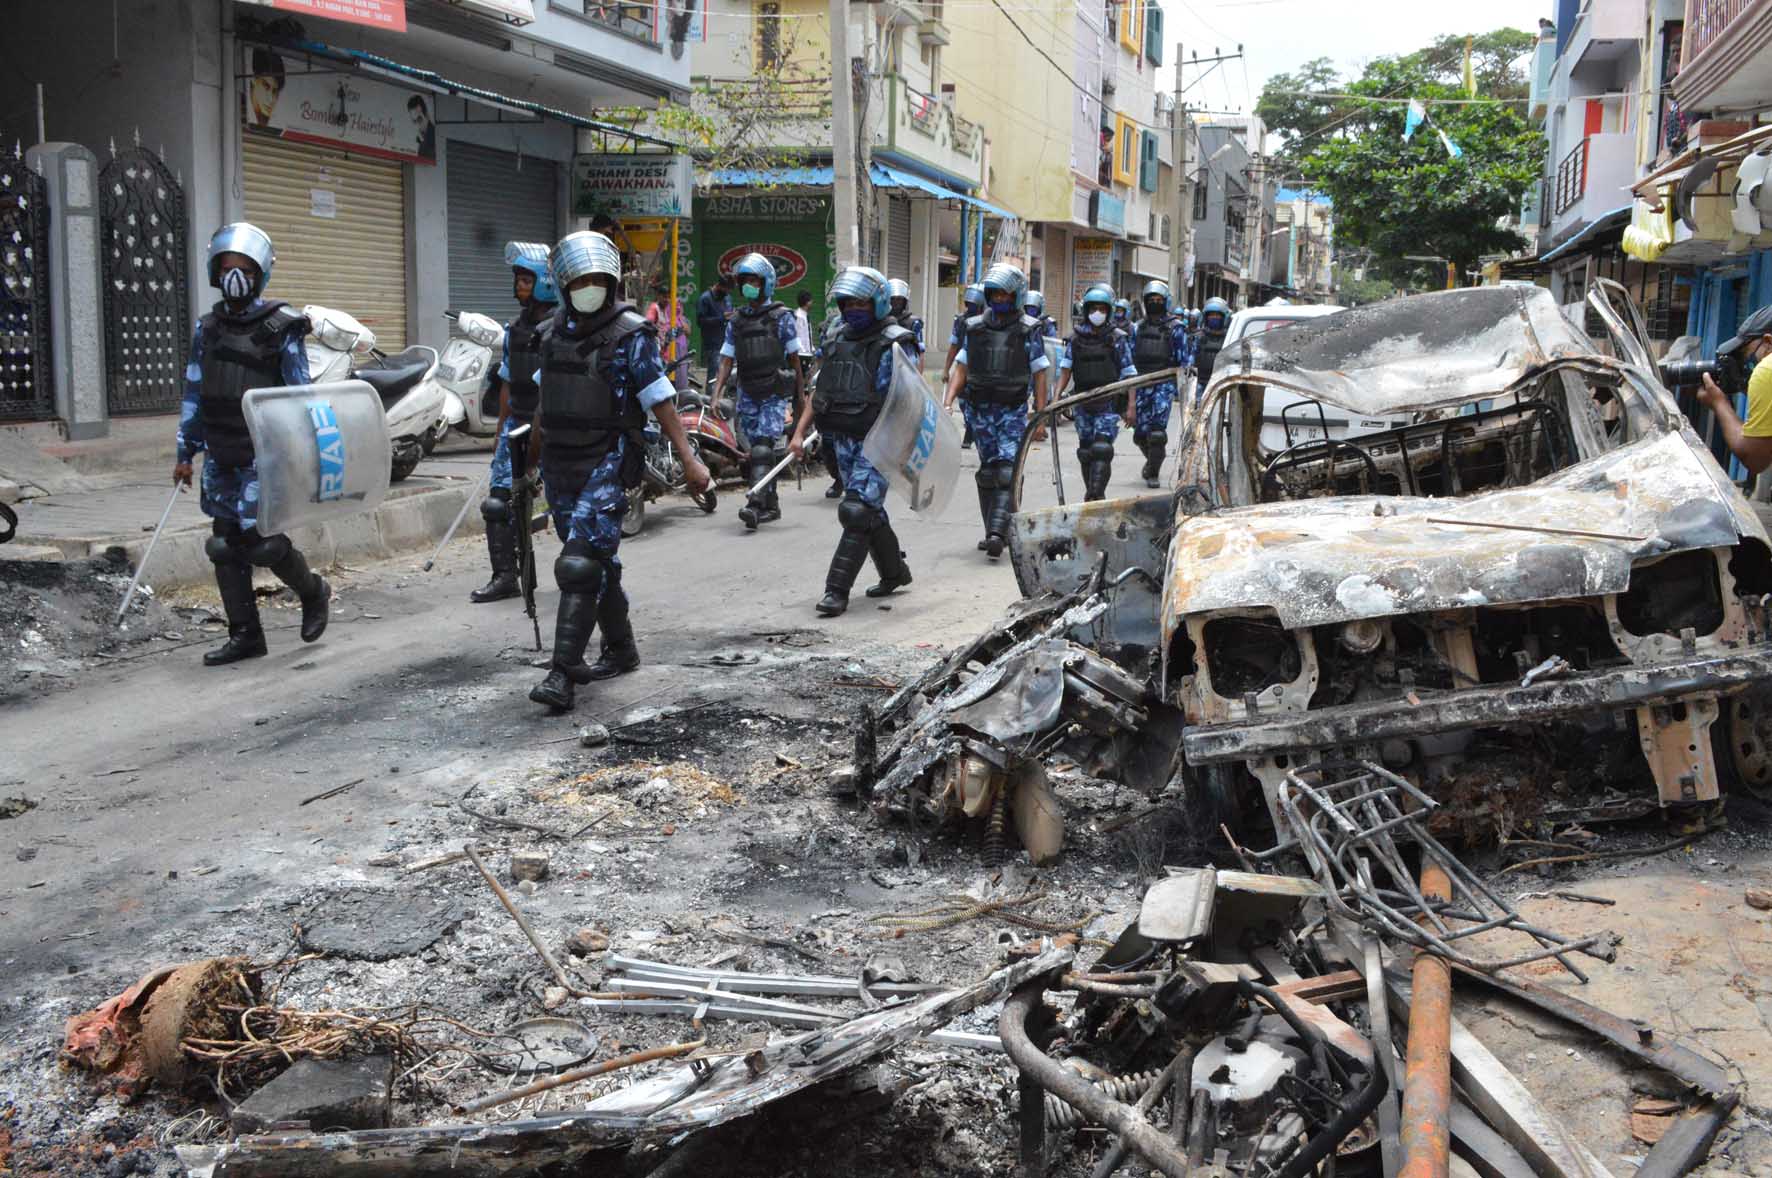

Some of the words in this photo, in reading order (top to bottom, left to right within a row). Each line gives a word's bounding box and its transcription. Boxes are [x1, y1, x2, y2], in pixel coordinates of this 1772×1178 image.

[351, 111, 395, 145] Hairstyle
[582, 178, 675, 190] DAWAKHANA
[587, 168, 631, 178] SHAHI
[634, 167, 668, 177] DESI
[706, 197, 753, 214] ASHA
[760, 197, 817, 215] STORES
[906, 399, 937, 471] RAF
[310, 407, 344, 500] RAF
